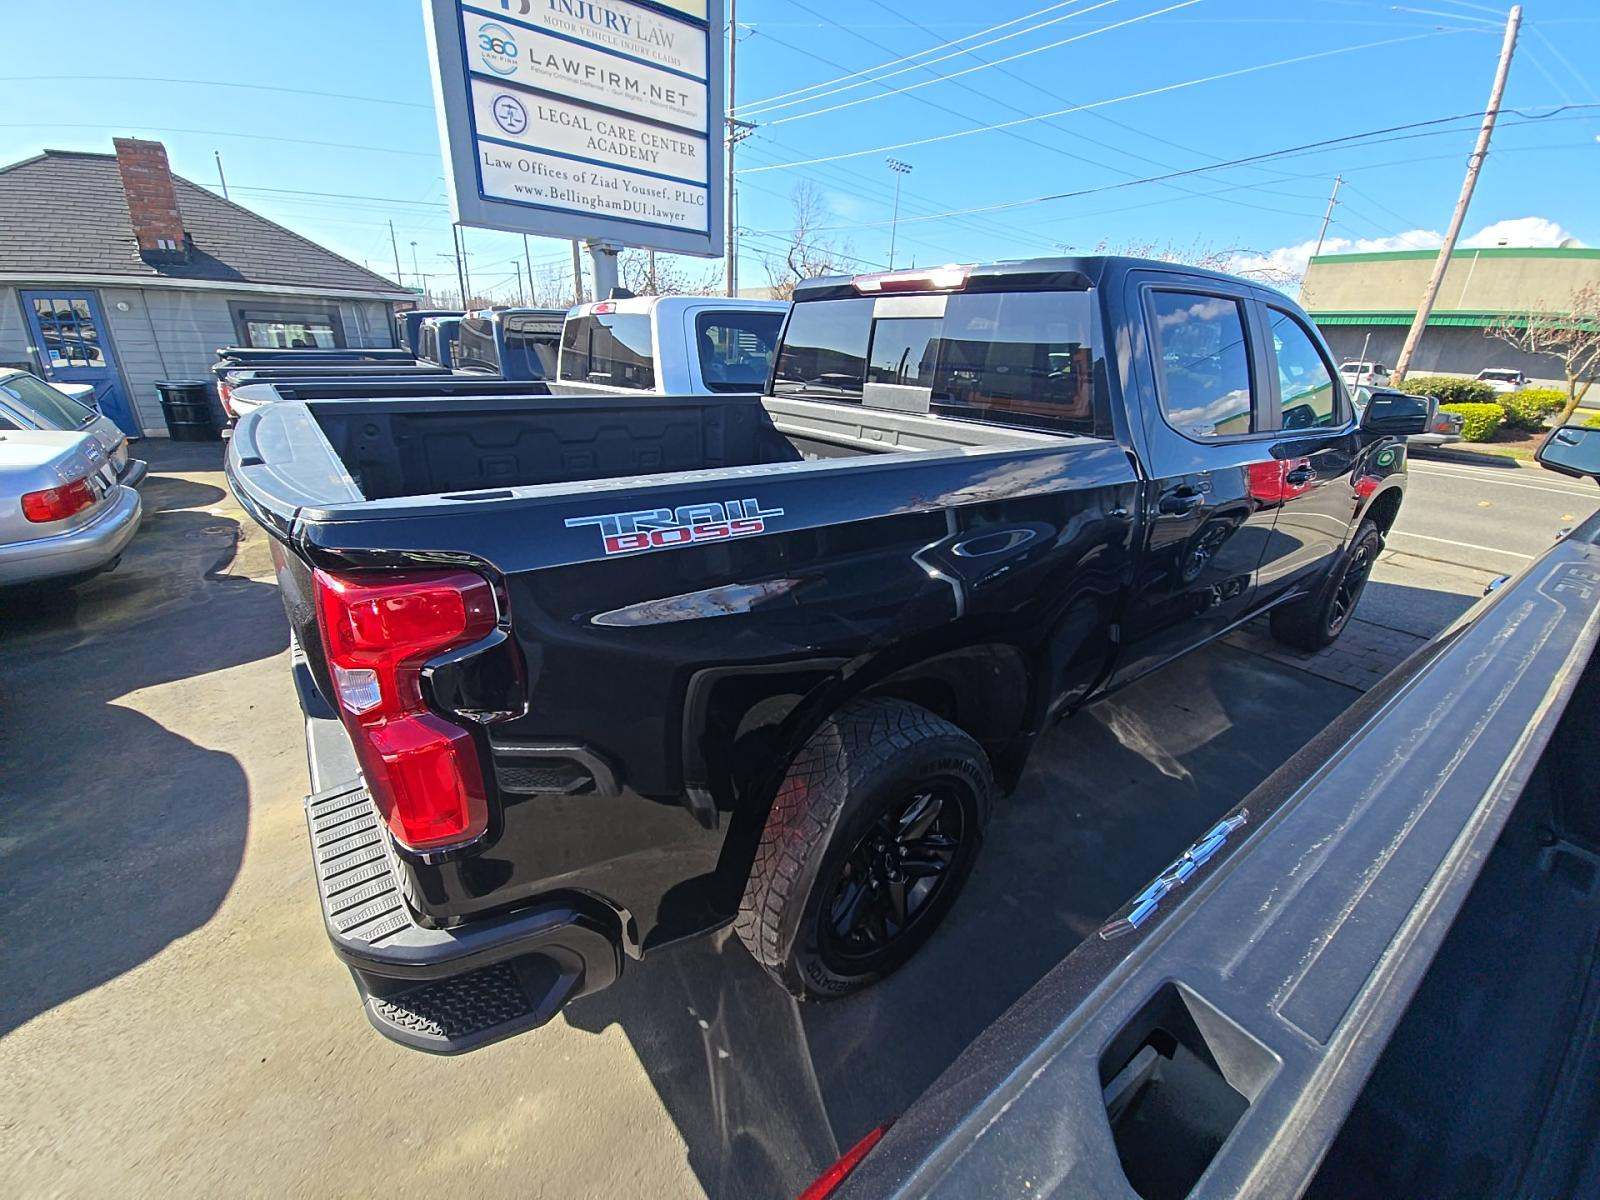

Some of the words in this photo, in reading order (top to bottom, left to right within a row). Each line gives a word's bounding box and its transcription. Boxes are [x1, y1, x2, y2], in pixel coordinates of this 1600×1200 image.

[478, 33, 518, 58] 360
[543, 14, 576, 32] MOTOR
[579, 26, 618, 46] VEHICLE
[620, 40, 650, 56] INJURY
[652, 51, 681, 67] CLAIMS
[636, 20, 675, 49] LAW
[529, 48, 690, 108] LAWFIRM.NET
[537, 105, 593, 132] LEGAL
[596, 121, 637, 143] CARE
[640, 132, 696, 158] CENTER
[586, 136, 660, 164] ACADEMY
[483, 152, 513, 170] Law
[517, 159, 568, 181] Offices
[572, 172, 587, 184] of
[590, 173, 618, 190] Ziad
[675, 190, 704, 206] PLLC
[513, 182, 687, 223] www.BellinghamDUI.lawyer
[565, 498, 784, 535] TRAIL
[604, 515, 765, 555] BOSS
